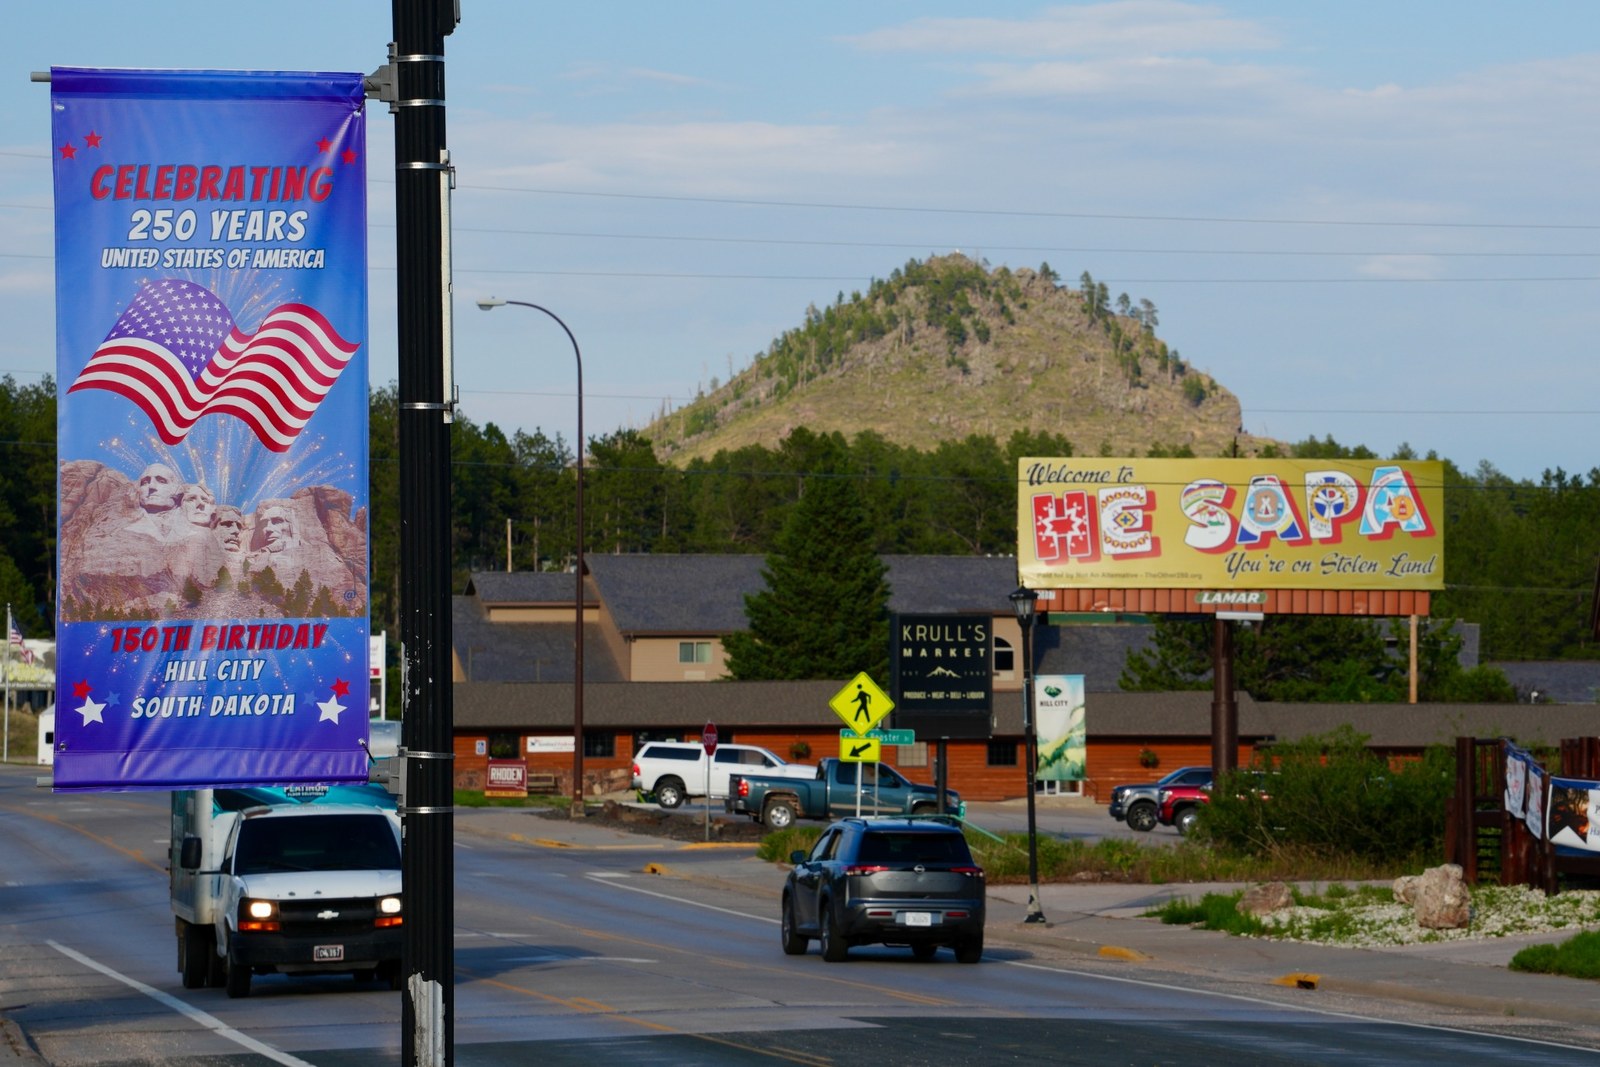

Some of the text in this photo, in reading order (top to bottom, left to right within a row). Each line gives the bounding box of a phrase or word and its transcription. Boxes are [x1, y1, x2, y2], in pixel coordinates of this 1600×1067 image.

[91, 164, 334, 202] CELEBRATING
[127, 208, 309, 242] 250 YEARS
[101, 247, 326, 269] UNITED STATES OF AMERICA
[1026, 463, 1133, 486] Welcome to
[1031, 466, 1430, 563] HE SAPA
[1224, 552, 1437, 579] You're on Stolen Land
[1201, 592, 1260, 604] LAMAR
[110, 623, 329, 652] 150TH BIRTHDAY
[902, 625, 986, 641] KRULL'S
[902, 648, 986, 657] MARKET
[164, 658, 266, 682] HILL CITY
[130, 693, 297, 719] SOUTH DAKOTA
[703, 733, 717, 746] STOP
[490, 767, 523, 781] RHODEN
